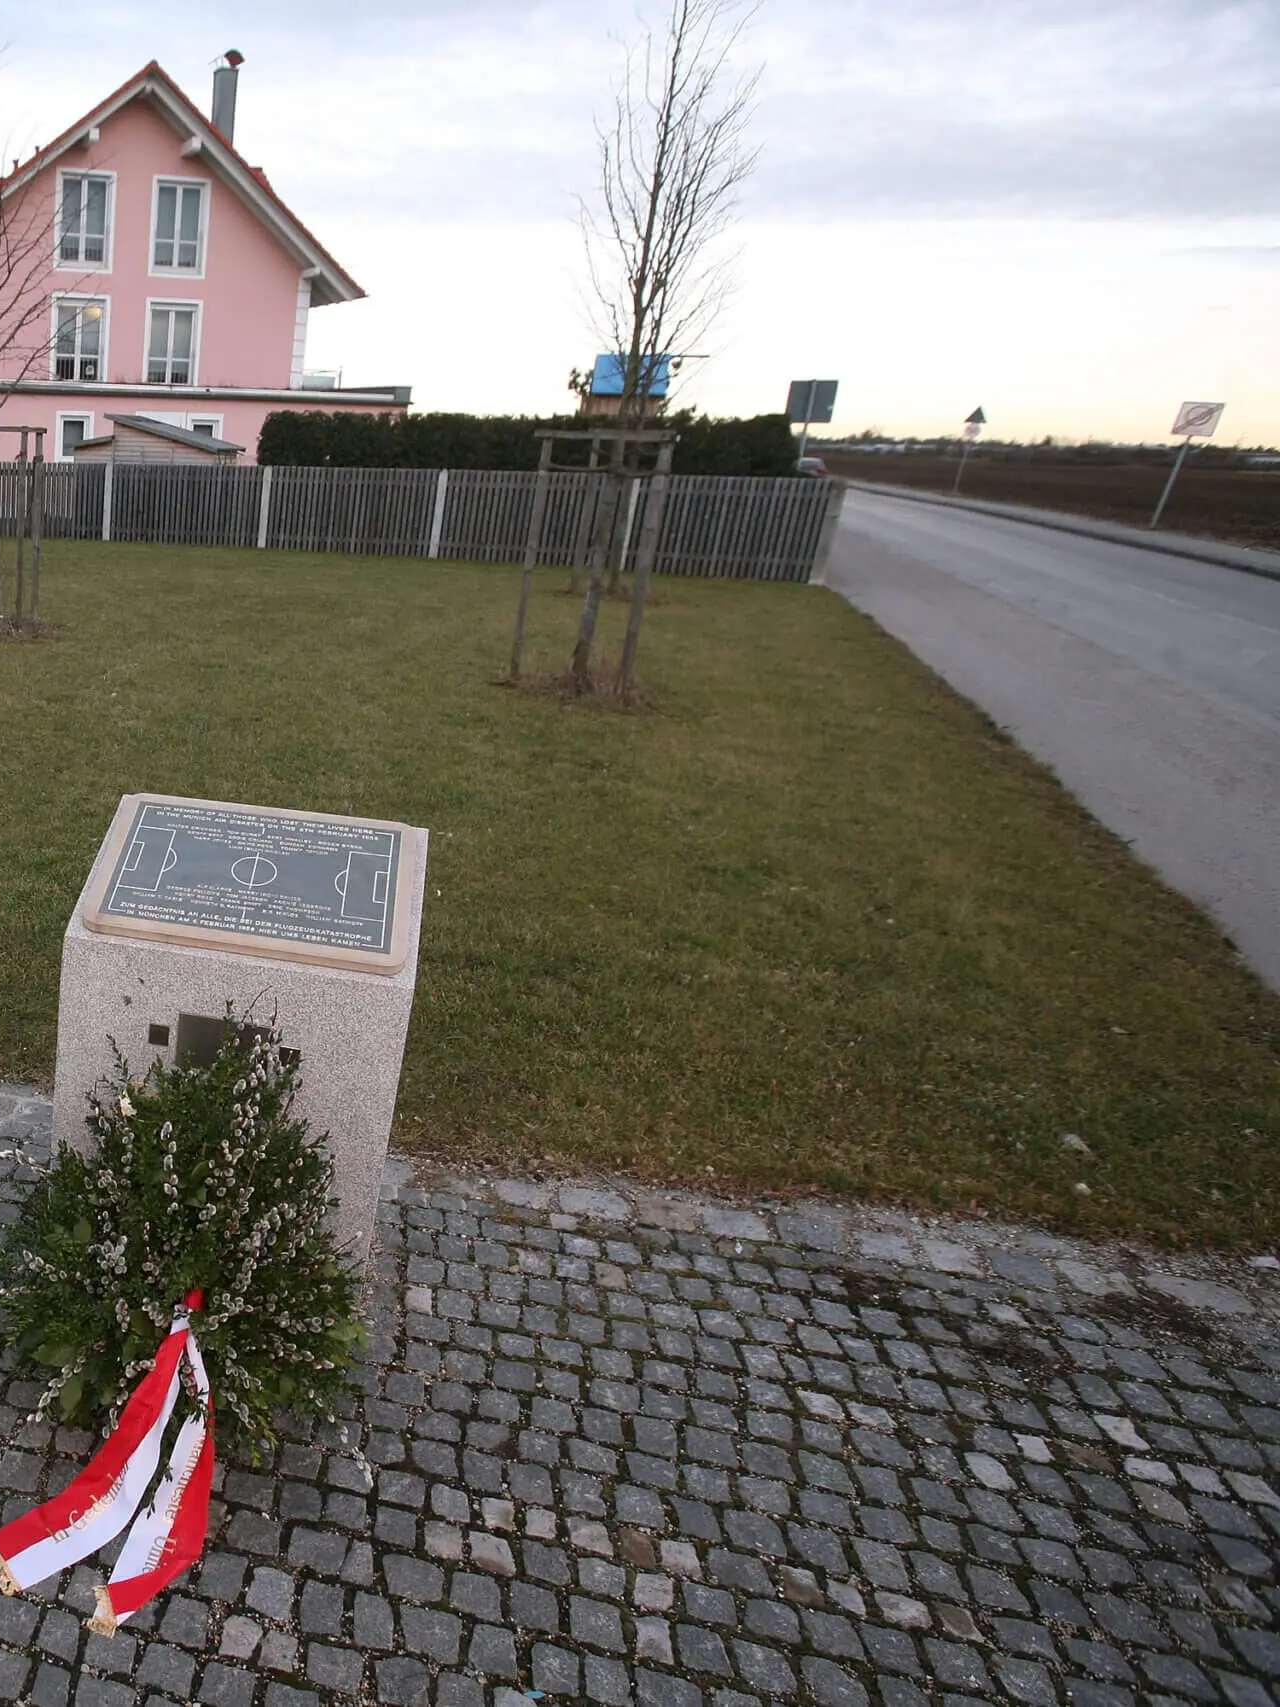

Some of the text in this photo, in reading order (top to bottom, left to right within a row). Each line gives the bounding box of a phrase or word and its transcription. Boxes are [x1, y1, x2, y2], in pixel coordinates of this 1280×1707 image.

[318, 830, 358, 838] FEBRUARY
[302, 933, 330, 942] LEBEN
[331, 938, 361, 947] KAMEN
[46, 1463, 128, 1543] In Gedenken
